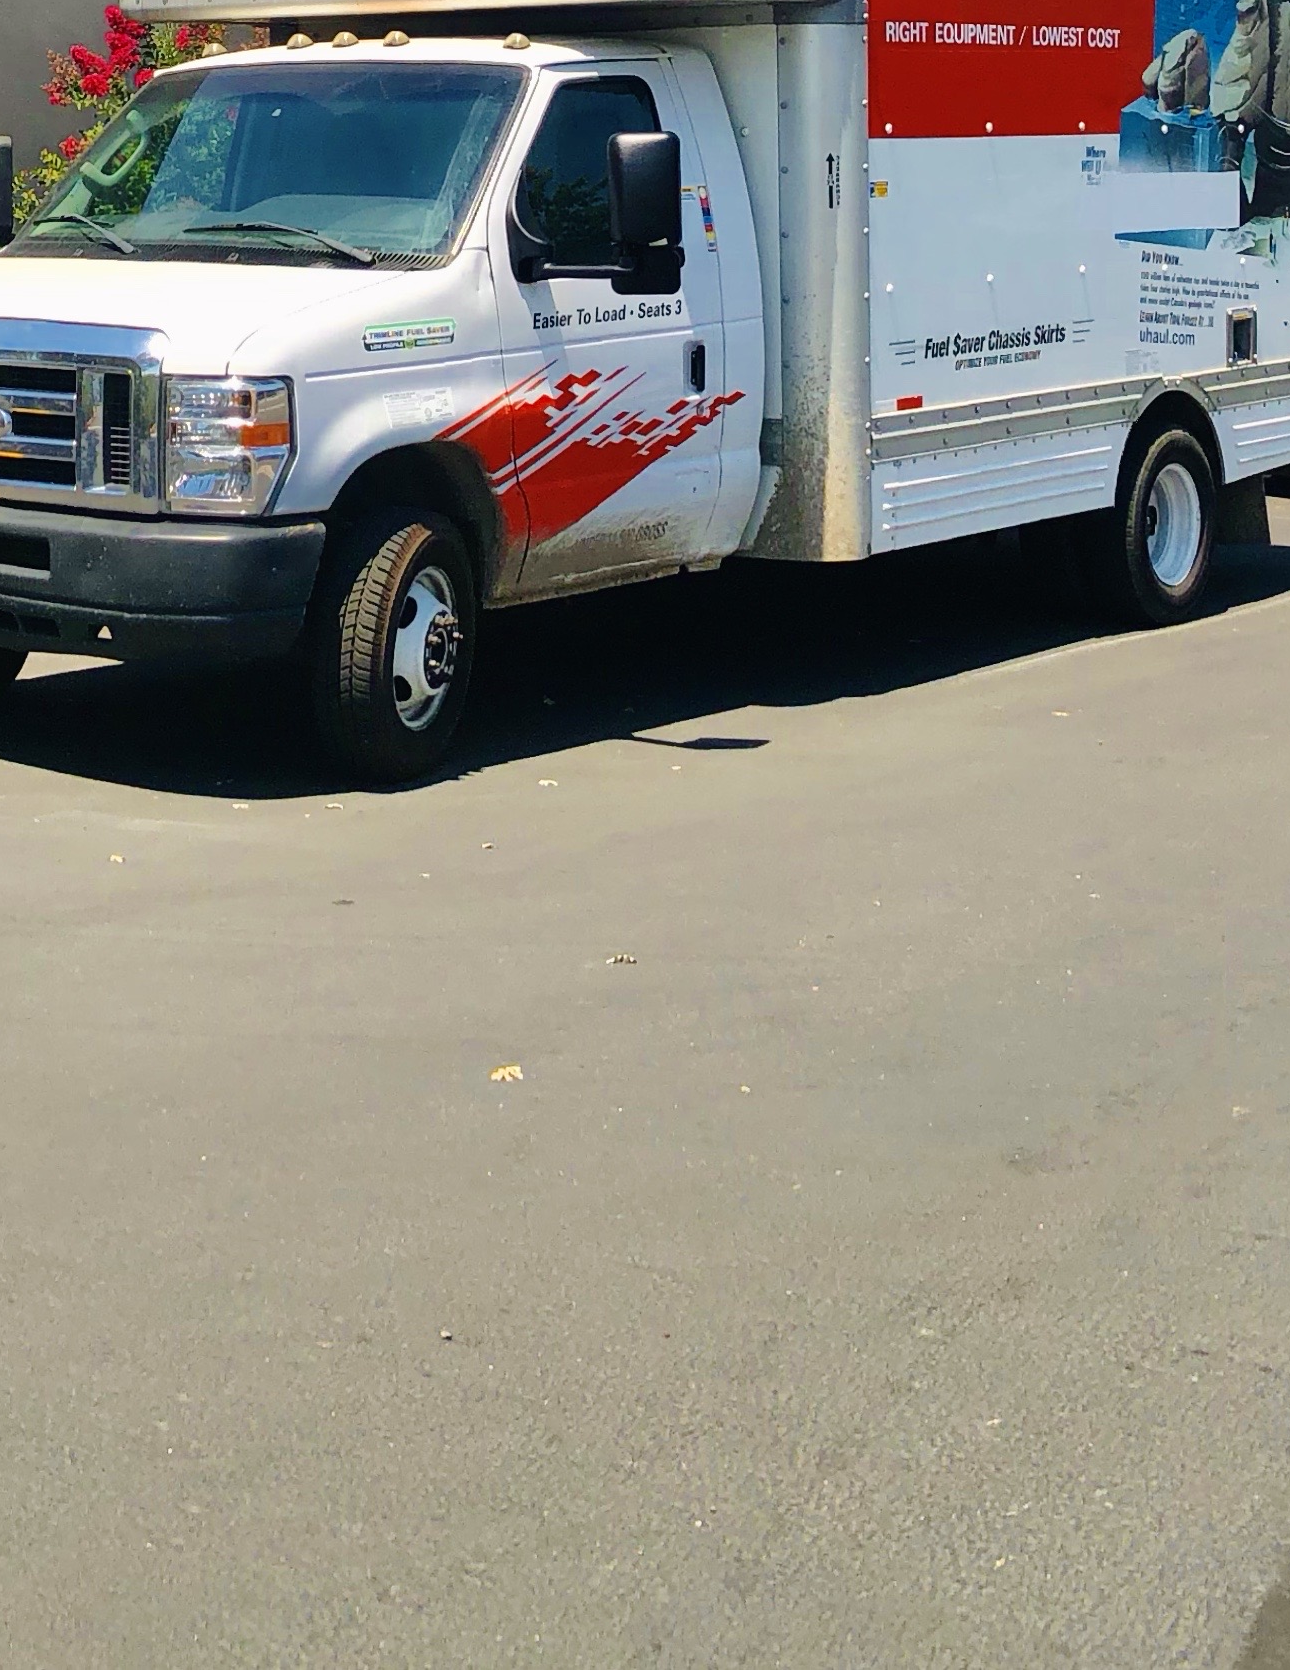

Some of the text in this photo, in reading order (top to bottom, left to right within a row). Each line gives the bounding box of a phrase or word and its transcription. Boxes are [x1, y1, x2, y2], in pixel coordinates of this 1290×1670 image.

[885, 21, 929, 43] RIGHT
[935, 22, 1016, 45] EQUIPMENT
[1032, 25, 1084, 46] LOWEST
[1087, 27, 1121, 48] COST
[533, 299, 682, 330] Easier To Load Seats 3
[924, 336, 951, 359] Fuel
[988, 327, 1031, 351] Chassis
[1033, 323, 1067, 346] Skirts
[1139, 327, 1195, 346] uhaul.com
